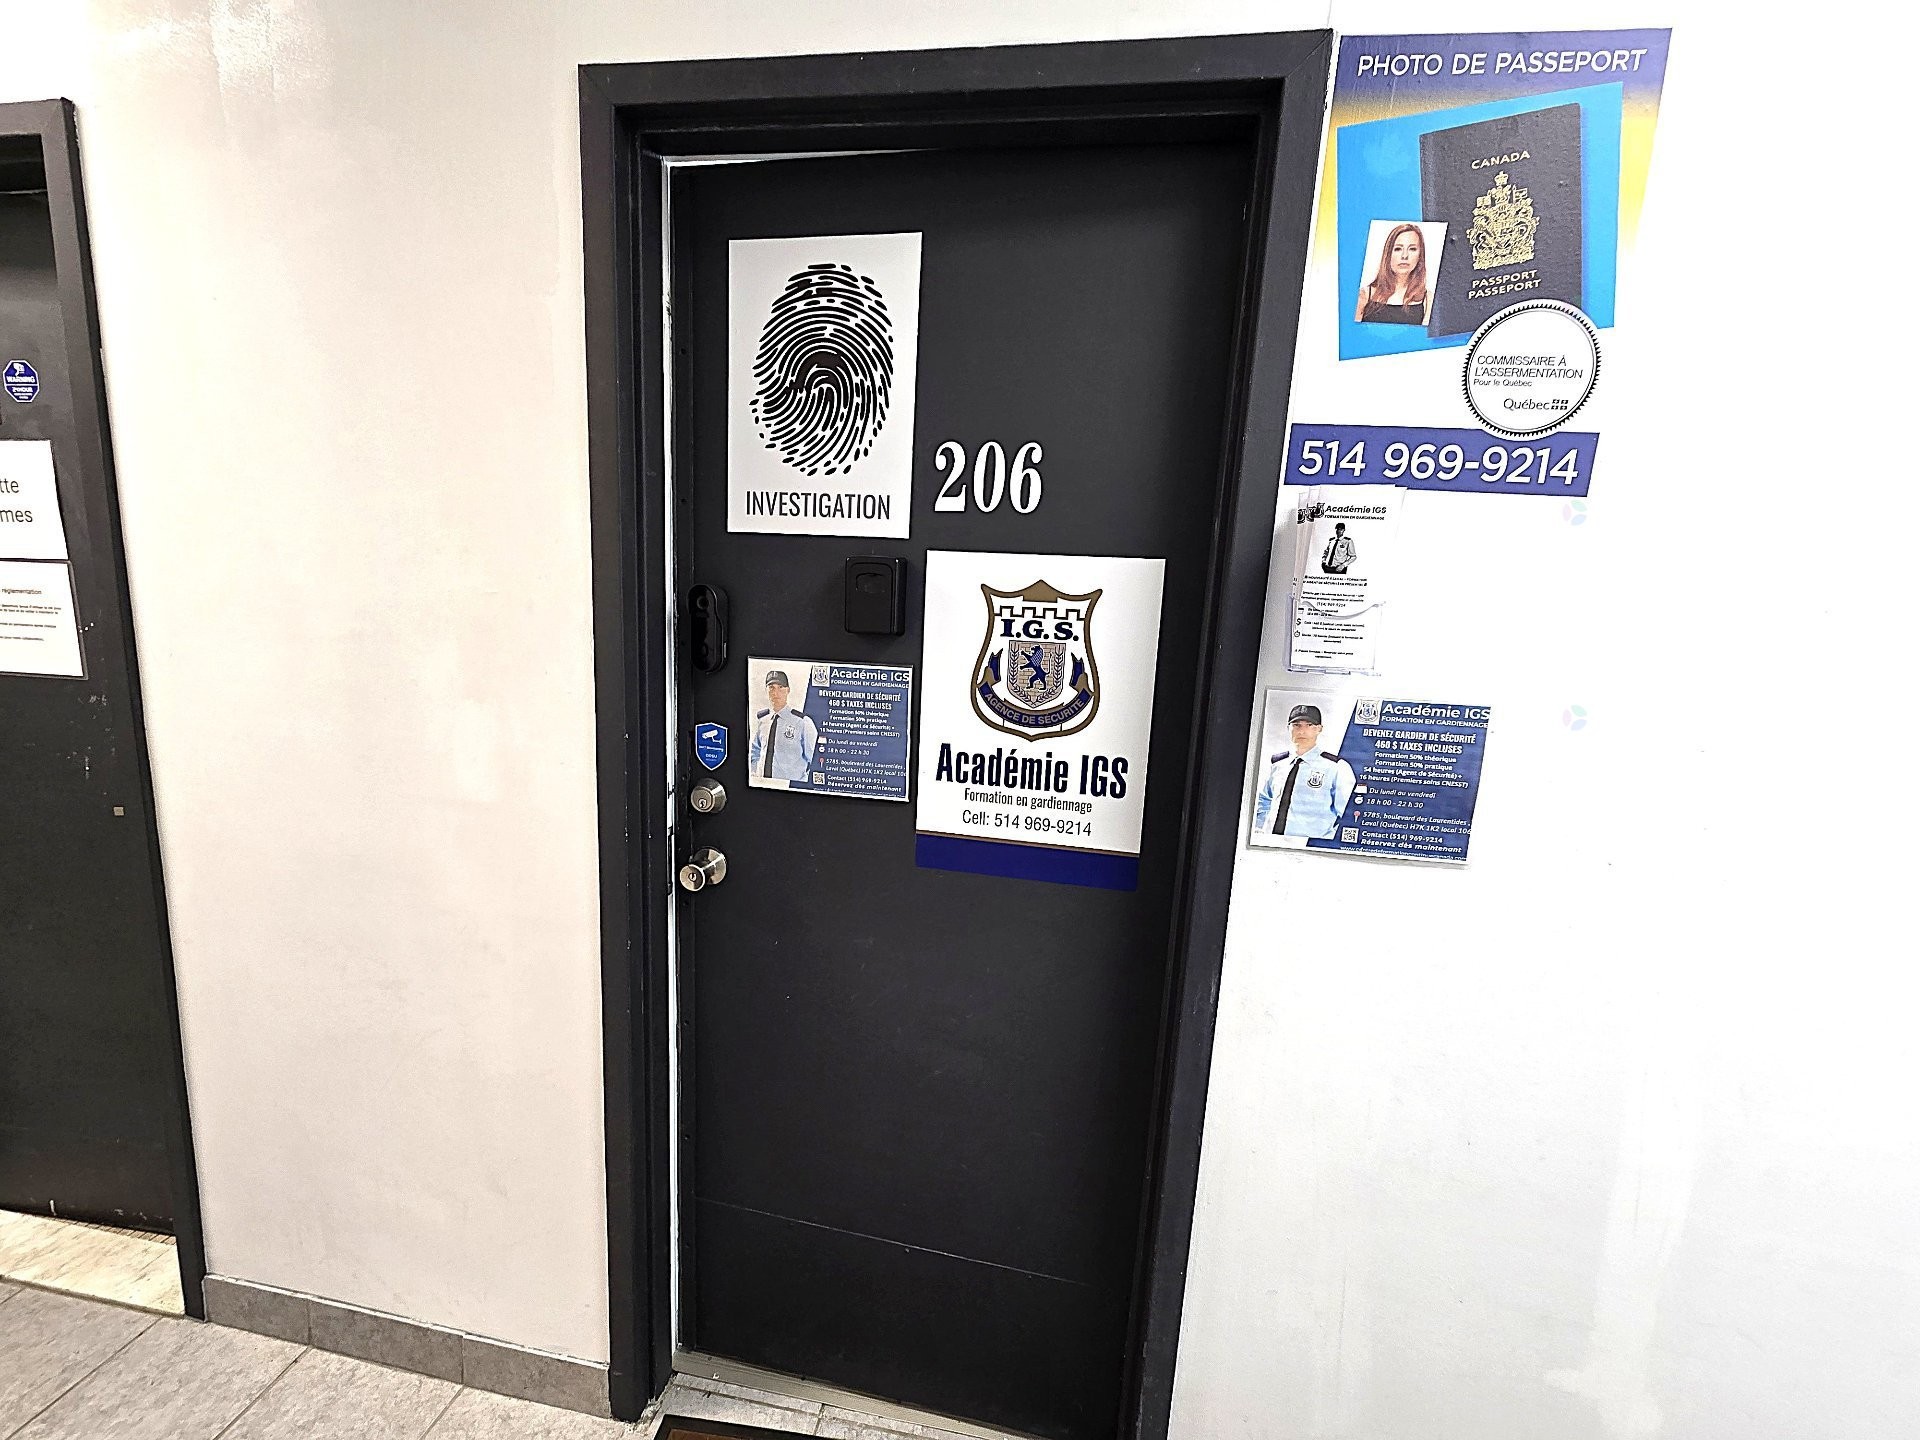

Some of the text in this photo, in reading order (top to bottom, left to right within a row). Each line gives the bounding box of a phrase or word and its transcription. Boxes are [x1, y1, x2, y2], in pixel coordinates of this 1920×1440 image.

[1357, 48, 1648, 77] PHOTO DE PASSEPORT
[1470, 150, 1531, 170] CANADA
[1472, 269, 1538, 288] PASSPORT
[1468, 279, 1542, 299] PASSEPORT
[1477, 354, 1567, 366] COMMISSAIRE À
[1475, 367, 1583, 378] L'ASSERMENTATION
[1503, 379, 1532, 387] Québec
[1503, 398, 1550, 411] Québec
[1299, 440, 1579, 485] 514 969-9214
[933, 440, 1043, 514] 206
[745, 490, 891, 520] INVESTIGATION
[1325, 505, 1370, 513] Académie
[1000, 618, 1079, 642] I.G.S.
[831, 668, 909, 682] Académie IGS
[819, 690, 841, 698] DEVENEZ
[842, 691, 865, 699] GARDIEN
[876, 692, 901, 702] SÉCURITÉ
[846, 700, 864, 708] TAXES
[865, 702, 892, 710] INCLUSES
[984, 693, 1020, 721] AGENCE
[1021, 714, 1036, 724] DE
[1382, 703, 1491, 720] Académie IGS
[1381, 716, 1424, 724] FORMATION
[1436, 720, 1489, 728] GARDIENNAGE
[1363, 728, 1476, 744] DEVENEZ GARDIEN DE SÉCURITÉ
[1375, 740, 1462, 754] 460 $ TAXES INCLUSES
[1375, 752, 1408, 760] Formation
[1424, 754, 1457, 763] théorique
[935, 742, 1129, 799] Académie IGS
[1409, 761, 1424, 769] 50%
[1424, 763, 1453, 771] pratique
[1391, 776, 1422, 784] (Premiers
[1396, 768, 1418, 776] (Agent
[1427, 771, 1457, 779] Sécurité)
[1407, 790, 1436, 798] vendredi
[964, 788, 1093, 815] Formation en gardiennage
[962, 810, 1092, 836] Cell: 514 969-9214
[1380, 821, 1408, 830] (Québec)
[1383, 813, 1415, 821] boulevard
[1416, 815, 1427, 823] des
[1429, 817, 1467, 826] Laurentides
[1362, 831, 1443, 843] Contact (514) 969-9214
[1361, 839, 1397, 848] Réservez
[1398, 841, 1412, 849] dès
[1415, 843, 1462, 853] maintenant
